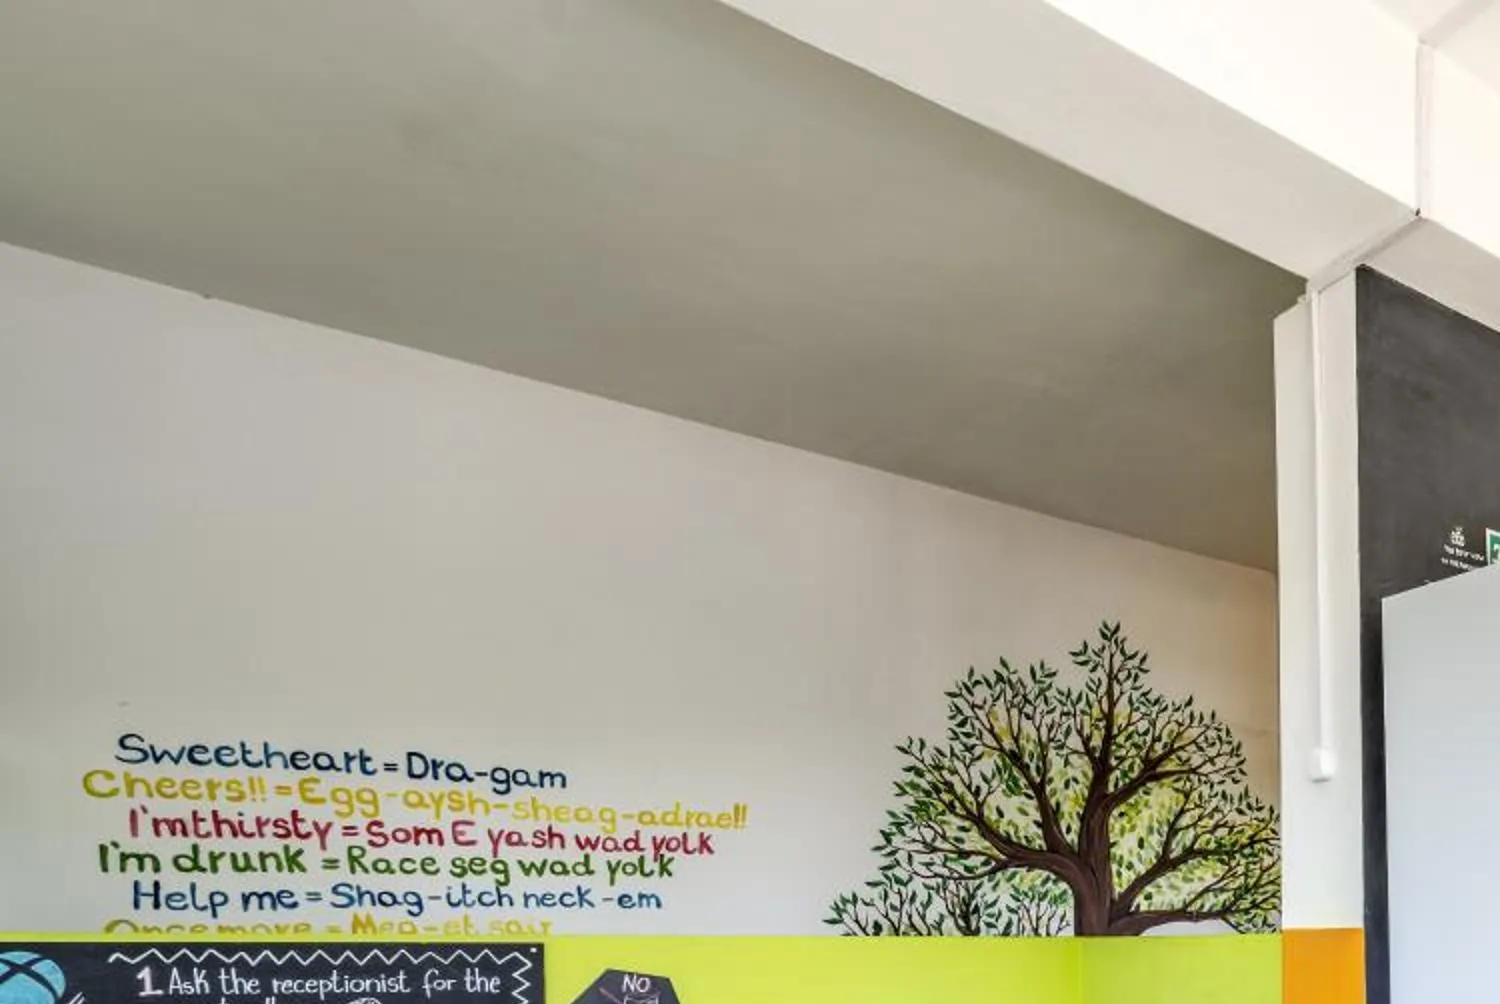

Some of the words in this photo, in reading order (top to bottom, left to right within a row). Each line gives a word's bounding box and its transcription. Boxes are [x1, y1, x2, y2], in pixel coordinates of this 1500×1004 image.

[115, 733, 377, 775] Sweetheart
[407, 751, 567, 795] Dra-gam
[487, 824, 566, 858] yash
[574, 830, 646, 854] wad
[651, 831, 715, 862] yolk
[172, 843, 308, 874] drunk
[347, 844, 441, 875] Race
[449, 855, 511, 887] seg
[517, 853, 595, 878] wad
[605, 854, 676, 886] yolk
[133, 880, 229, 918] Help
[241, 888, 299, 912] me
[329, 882, 514, 917] Shag-itch
[523, 884, 596, 909] neck
[169, 967, 211, 995] Ask
[218, 967, 261, 995] the
[271, 969, 411, 1001] receptionist
[422, 968, 457, 999] for
[464, 967, 502, 994] the
[622, 973, 651, 993] NO
